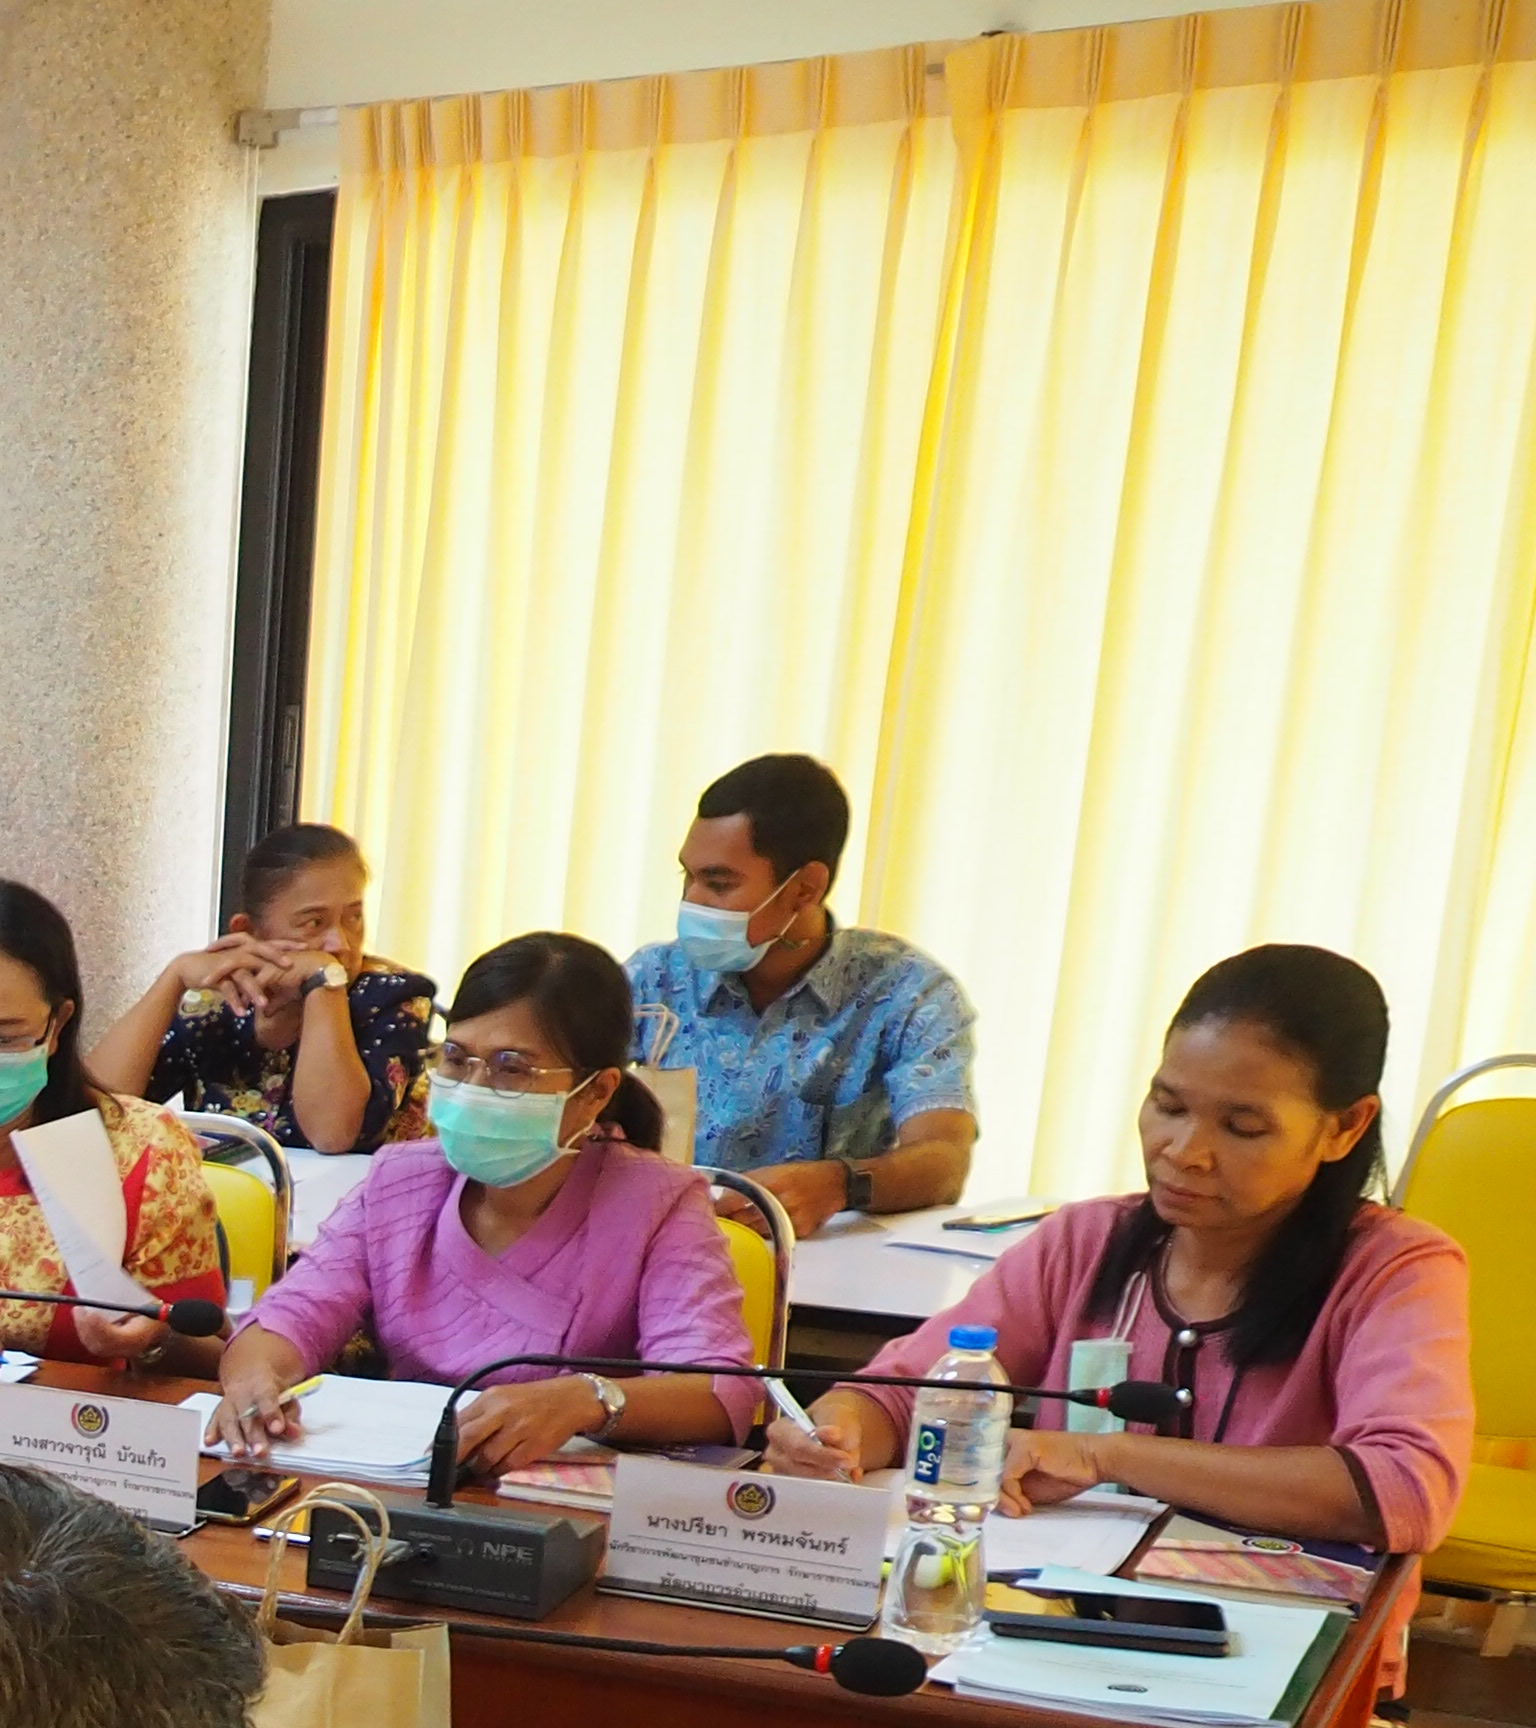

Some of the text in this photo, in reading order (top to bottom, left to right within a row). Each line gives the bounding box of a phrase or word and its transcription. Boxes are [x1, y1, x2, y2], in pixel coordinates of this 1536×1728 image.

[116, 1445, 167, 1469] บัวแก้ว
[646, 1513, 851, 1556] นางปรียา พรหมจันทร์
[482, 1541, 535, 1560] NPE
